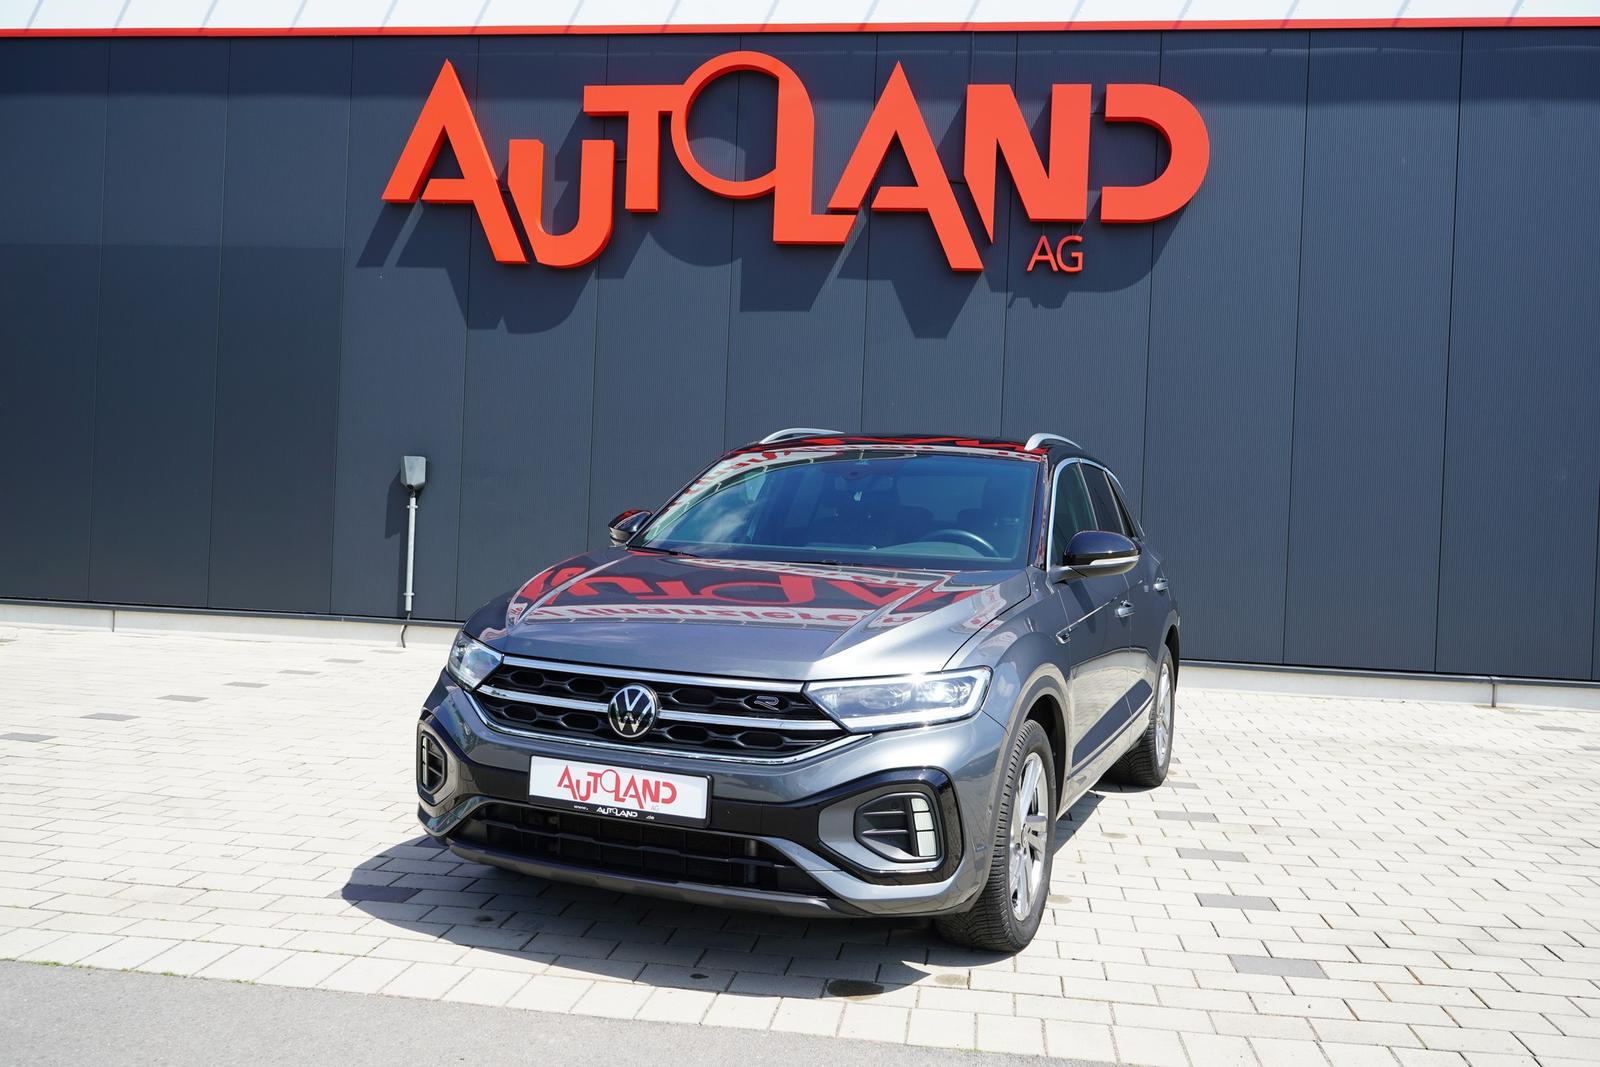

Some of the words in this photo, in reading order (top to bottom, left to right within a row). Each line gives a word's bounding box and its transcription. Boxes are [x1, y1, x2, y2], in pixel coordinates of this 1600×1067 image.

[381, 50, 1210, 272] AUTOLAND
[1027, 235, 1083, 273] AG
[557, 764, 677, 809] AUTOLAND
[596, 806, 638, 818] AUTOLAND
